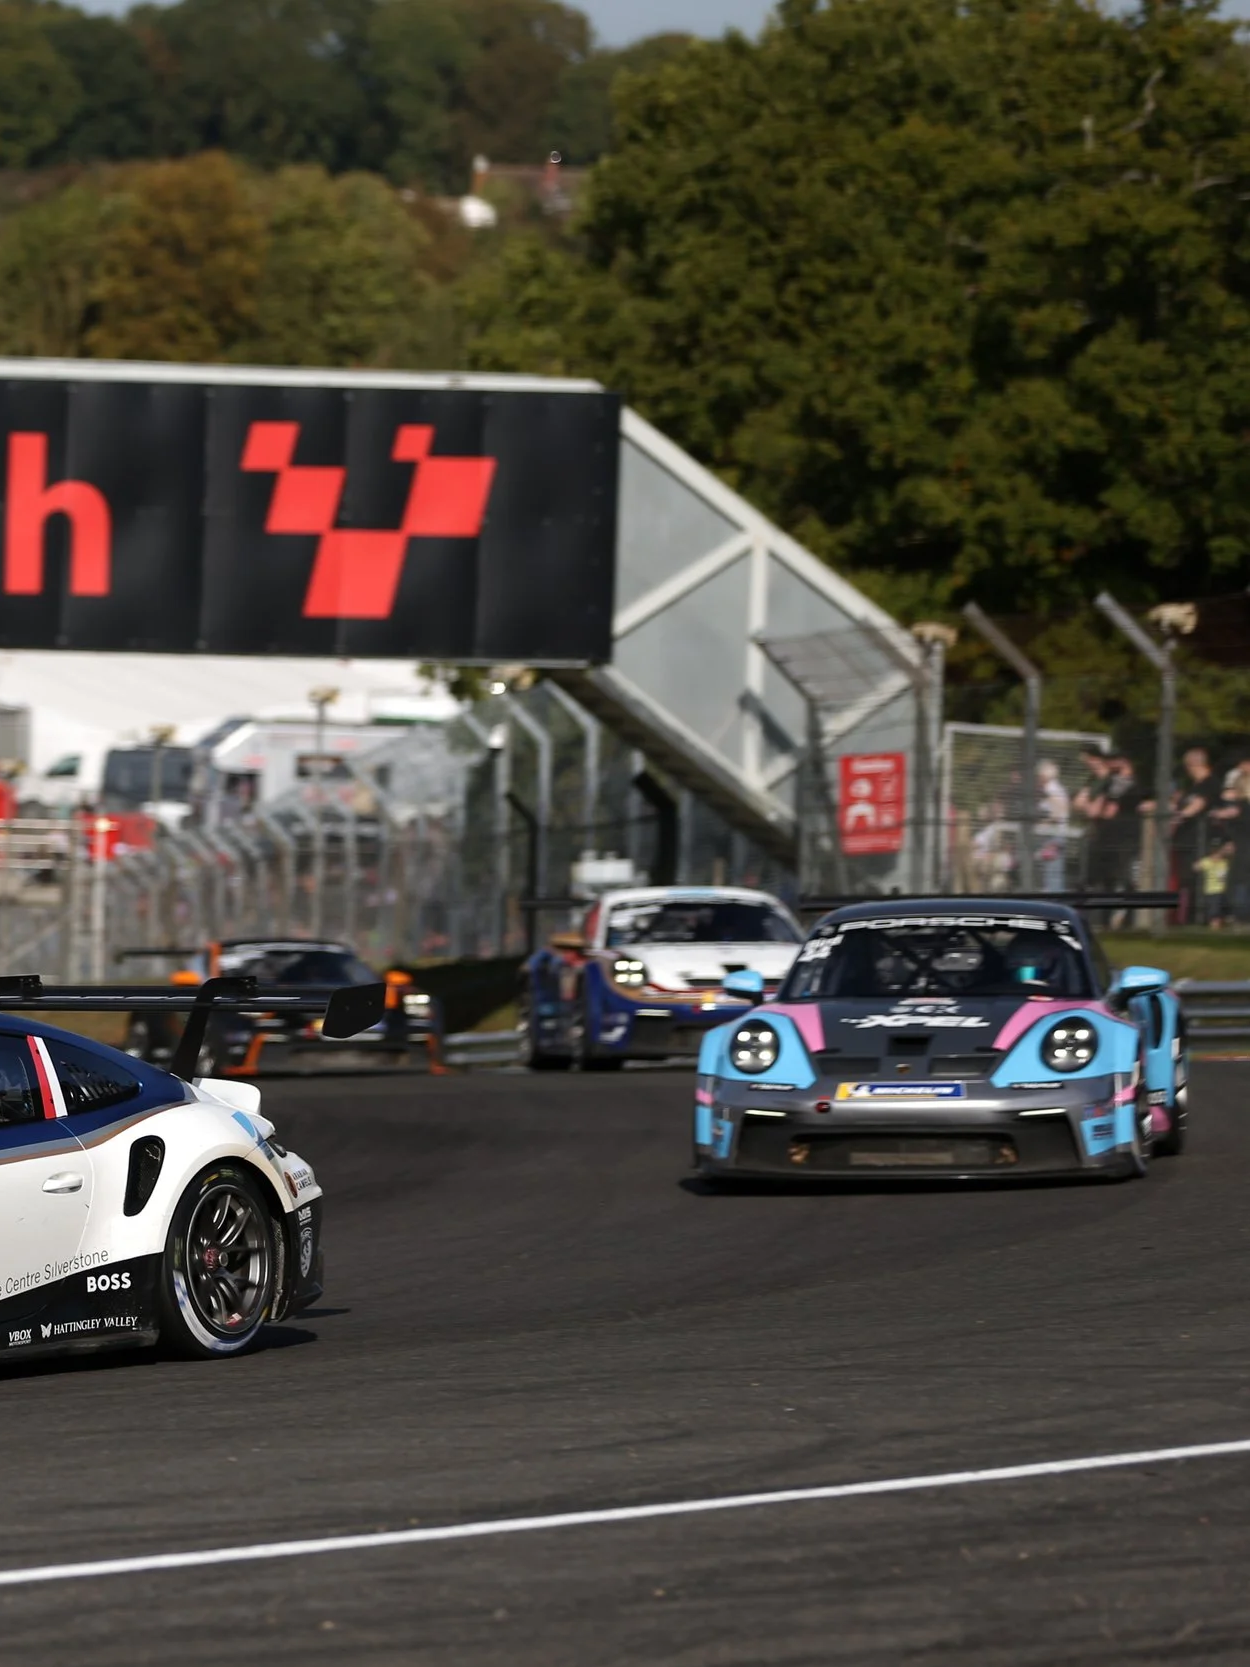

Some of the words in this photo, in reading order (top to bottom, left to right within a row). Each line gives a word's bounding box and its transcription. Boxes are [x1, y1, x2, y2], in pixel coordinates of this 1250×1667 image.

[839, 917, 1048, 932] PORSCHE
[5, 1270, 41, 1294] Centre
[44, 1249, 109, 1281] Silverstone
[86, 1272, 132, 1293] BOSS
[8, 1328, 32, 1342] VBOX
[53, 1318, 102, 1336] HATTINGLEY
[103, 1316, 138, 1328] VALLEY
